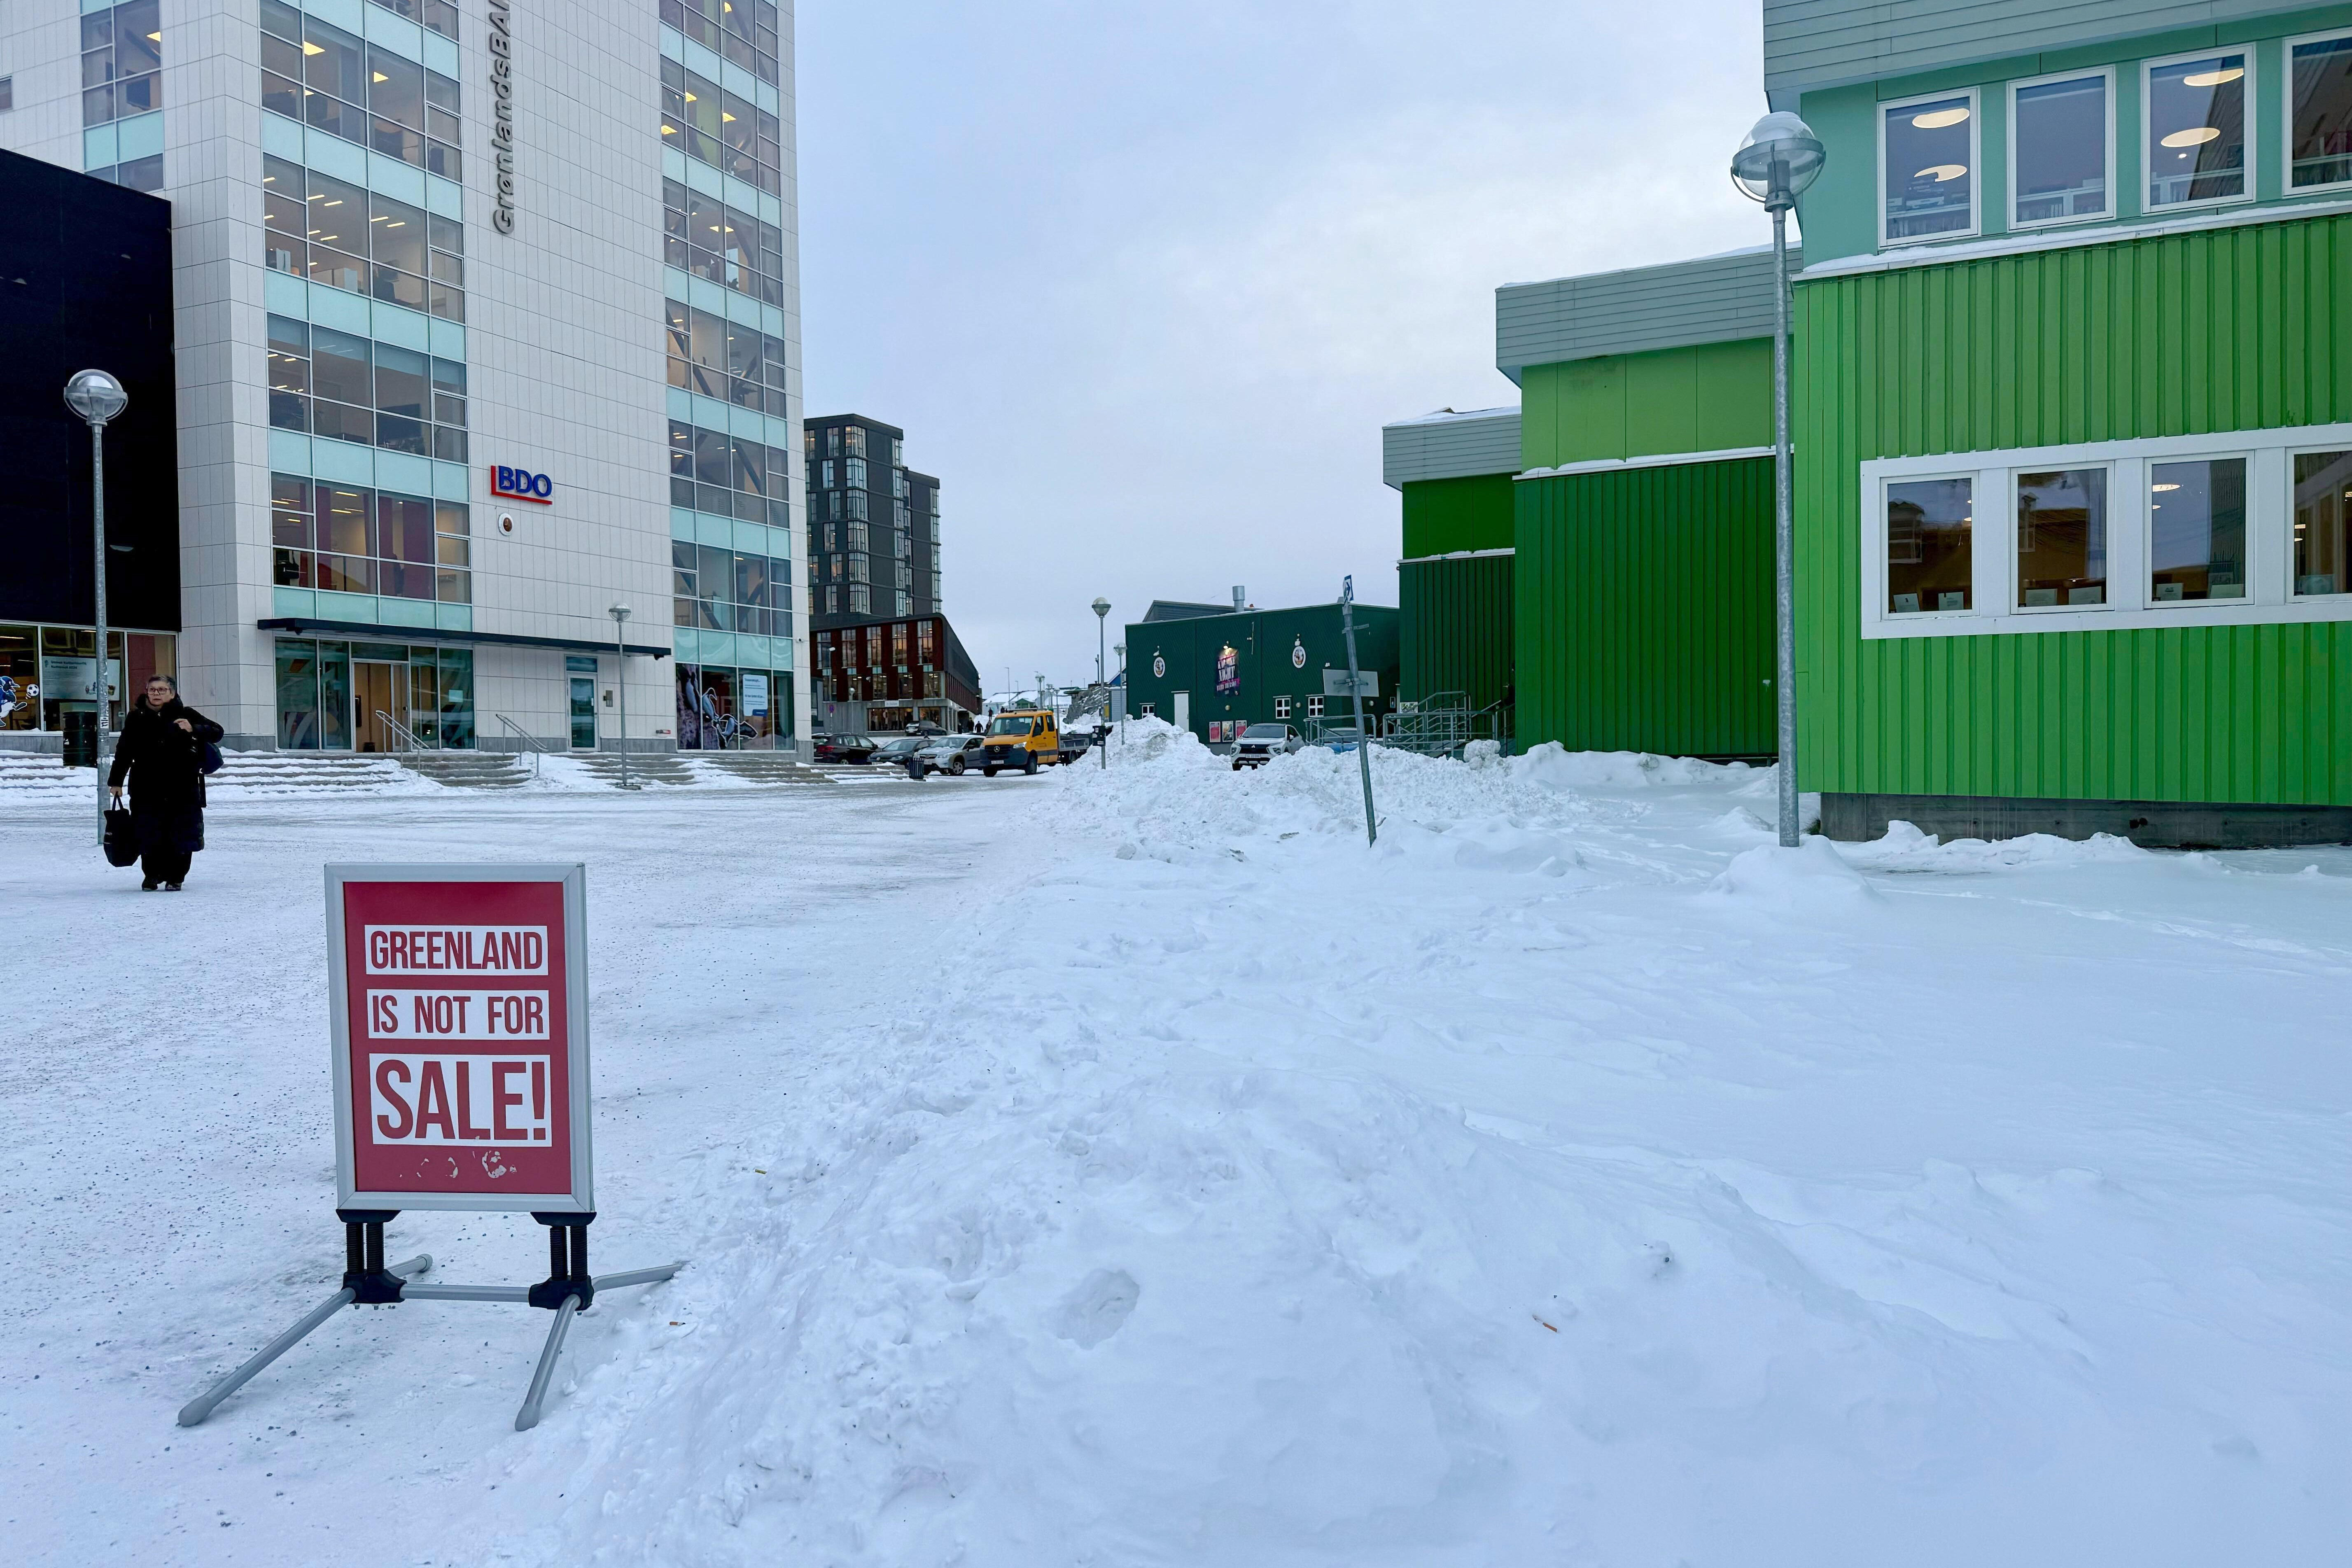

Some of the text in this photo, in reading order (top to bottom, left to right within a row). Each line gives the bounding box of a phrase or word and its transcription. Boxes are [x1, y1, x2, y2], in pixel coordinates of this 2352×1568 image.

[498, 465, 552, 497] BDO
[371, 931, 542, 969] GREENLAND
[372, 995, 544, 1034] IS NOT FOR
[376, 1059, 546, 1140] SALE!
